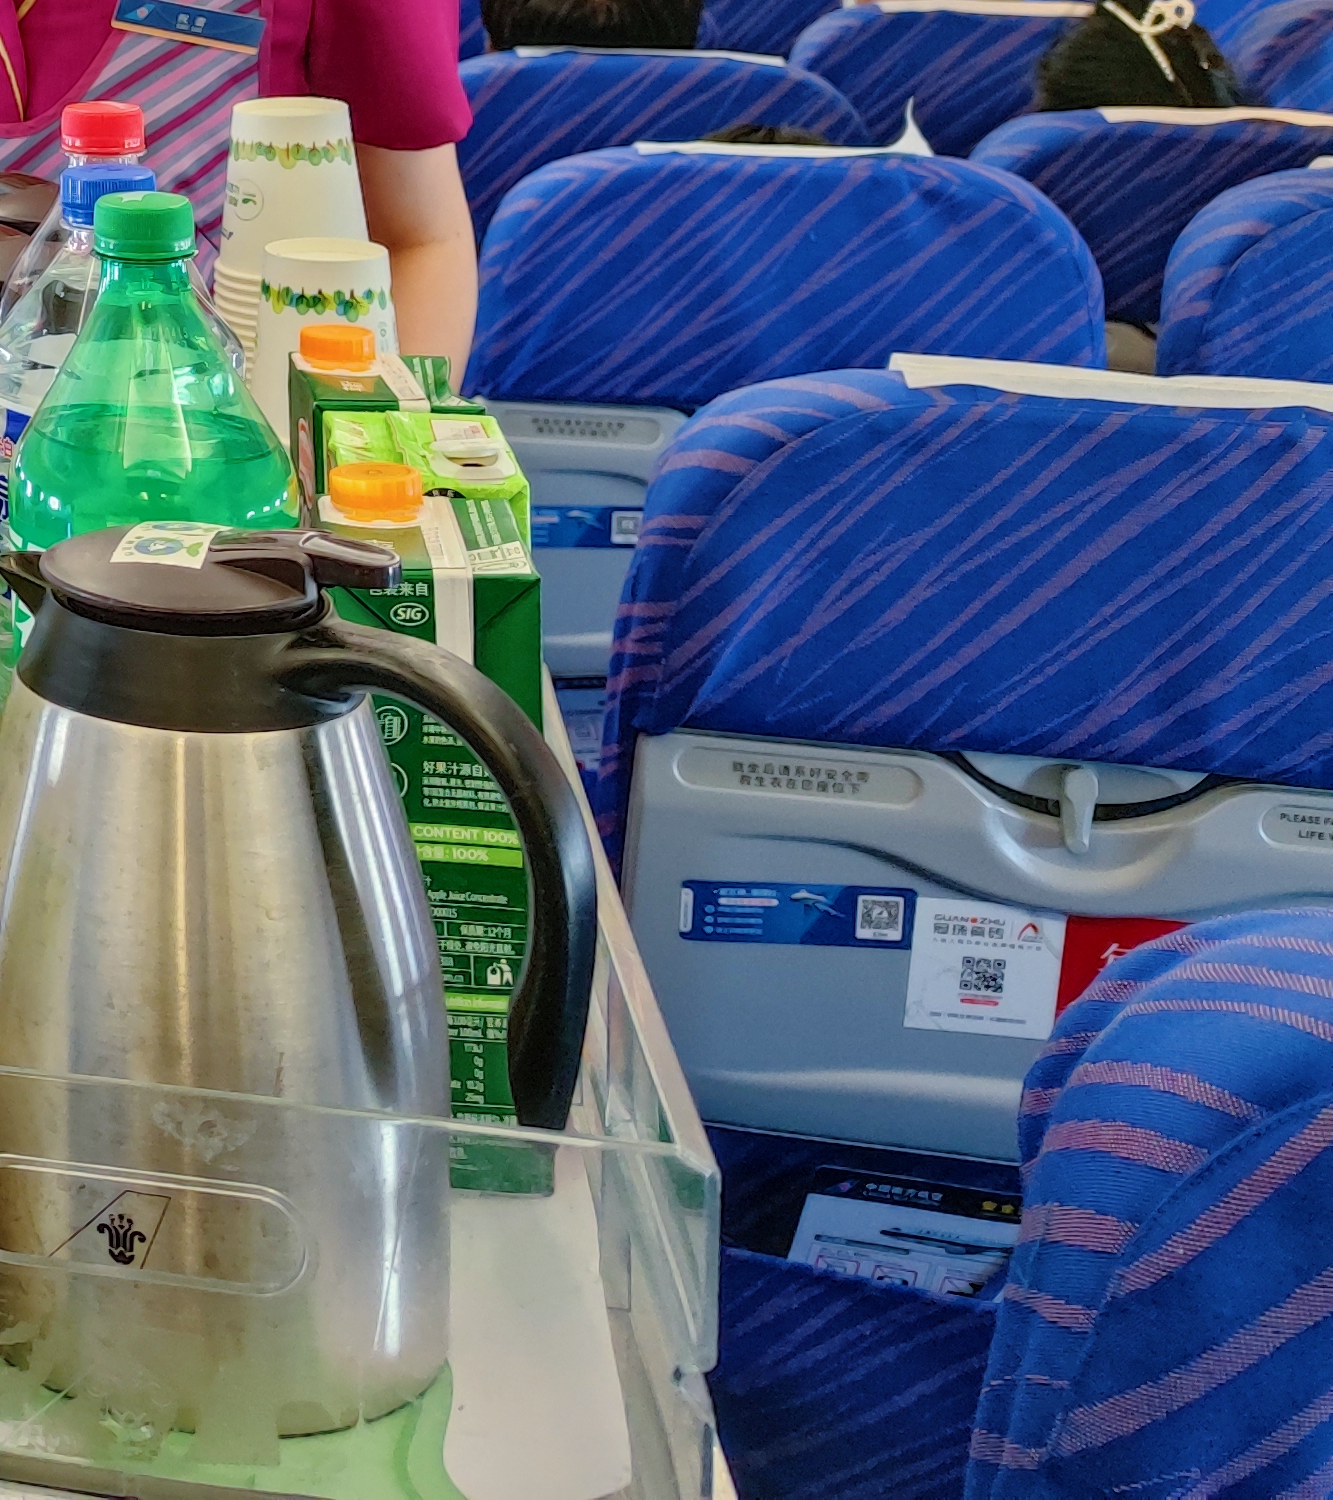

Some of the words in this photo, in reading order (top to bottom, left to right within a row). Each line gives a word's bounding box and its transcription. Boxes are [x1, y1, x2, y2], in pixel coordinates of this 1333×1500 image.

[396, 607, 422, 621] SIG
[1279, 812, 1320, 825] PLEASE
[413, 825, 479, 841] CONTENT
[483, 831, 520, 845] 100%
[1298, 830, 1325, 841] LIFE
